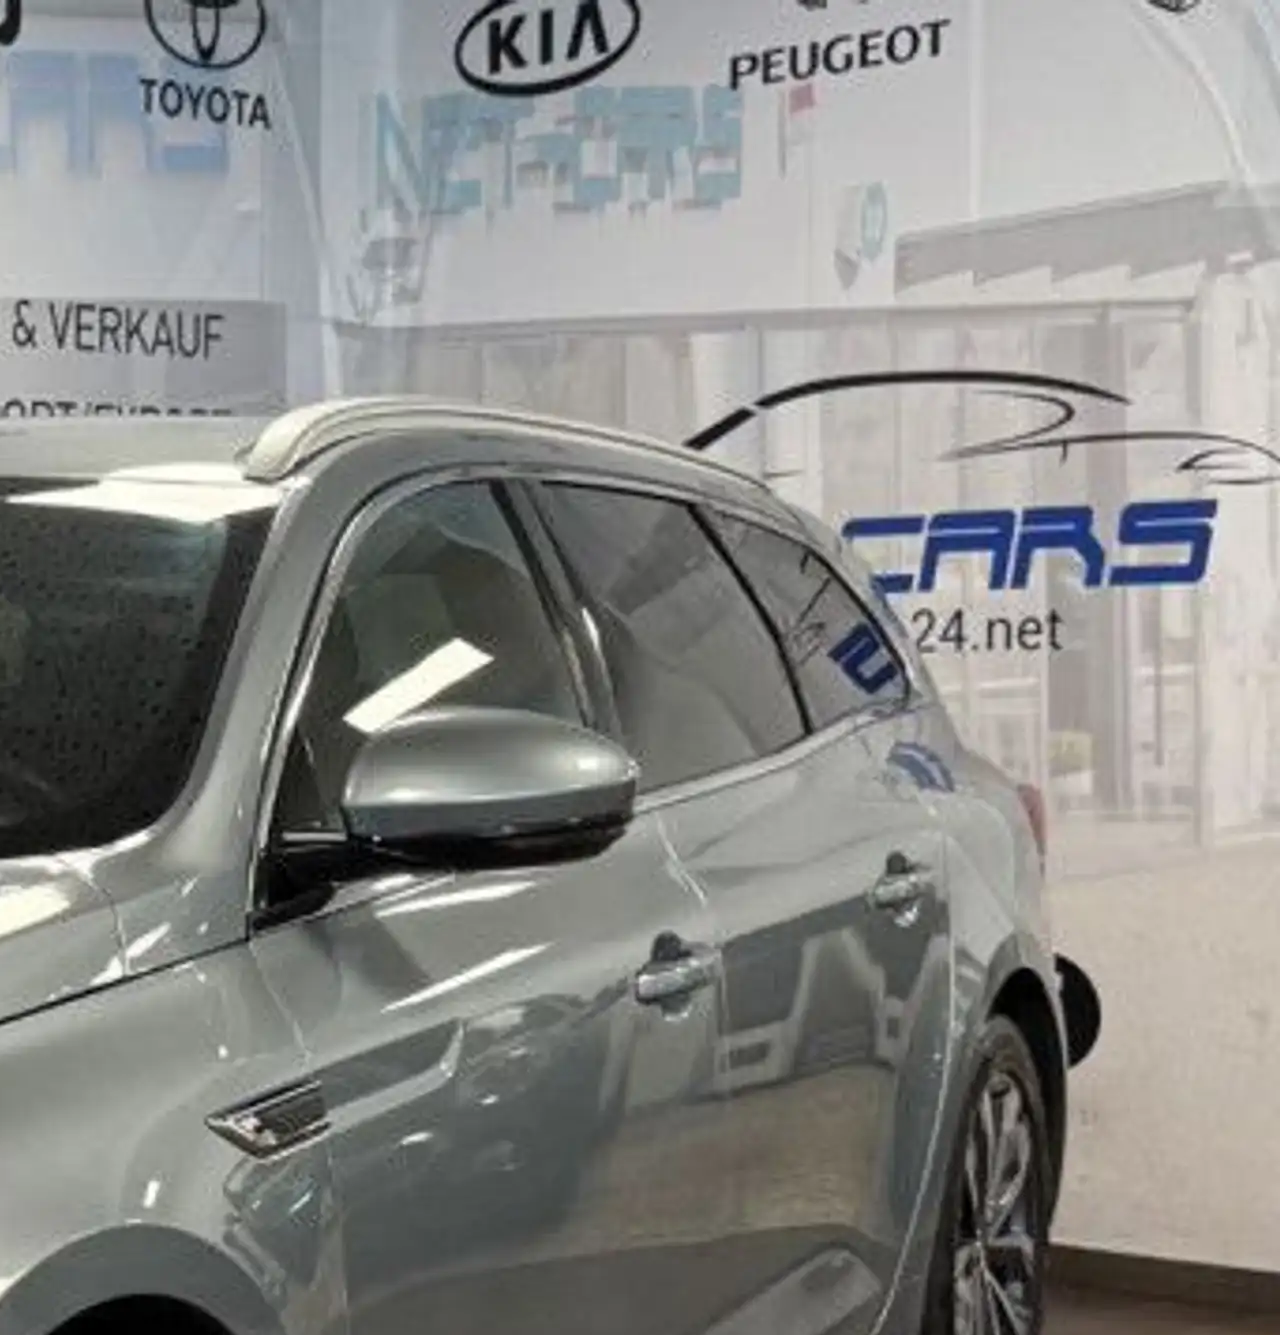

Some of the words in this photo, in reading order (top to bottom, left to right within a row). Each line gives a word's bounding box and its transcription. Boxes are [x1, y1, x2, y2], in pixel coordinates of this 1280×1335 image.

[486, 3, 611, 76] KIA
[730, 20, 950, 90] PEUGEOT
[142, 77, 272, 130] TOYOTA
[12, 299, 37, 348] &
[48, 302, 224, 361] VERKAUF
